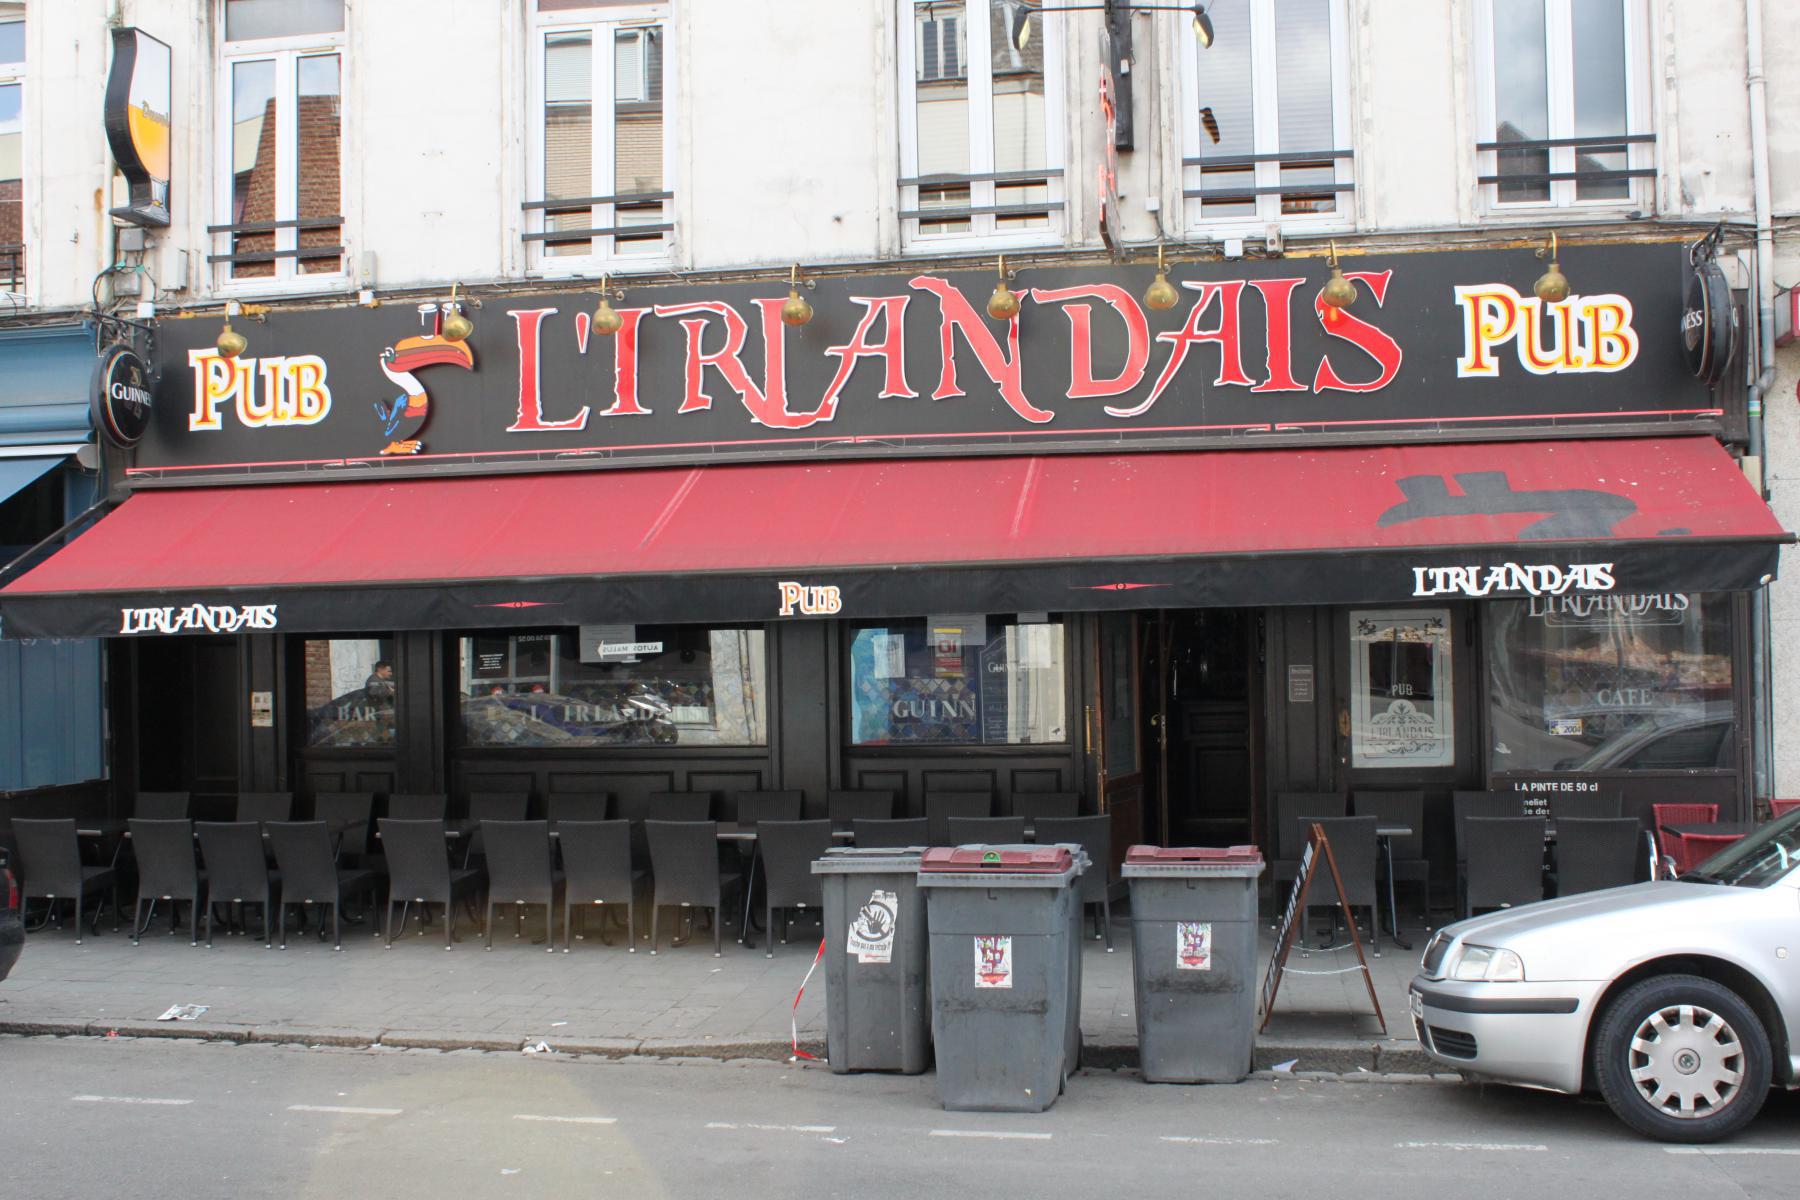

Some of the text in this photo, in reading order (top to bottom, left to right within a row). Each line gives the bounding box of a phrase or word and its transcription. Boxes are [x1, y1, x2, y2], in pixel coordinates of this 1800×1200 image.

[1454, 284, 1639, 378] PUB
[506, 269, 1403, 433] L'IRLANDAIS
[188, 348, 332, 431] PUB
[778, 581, 842, 615] PUB
[1392, 684, 1413, 696] PUB
[337, 706, 377, 721] BAR
[1514, 783, 1528, 791] LA
[1531, 783, 1559, 791] PINTE
[1561, 783, 1574, 791] DE
[1576, 783, 1587, 791] 50
